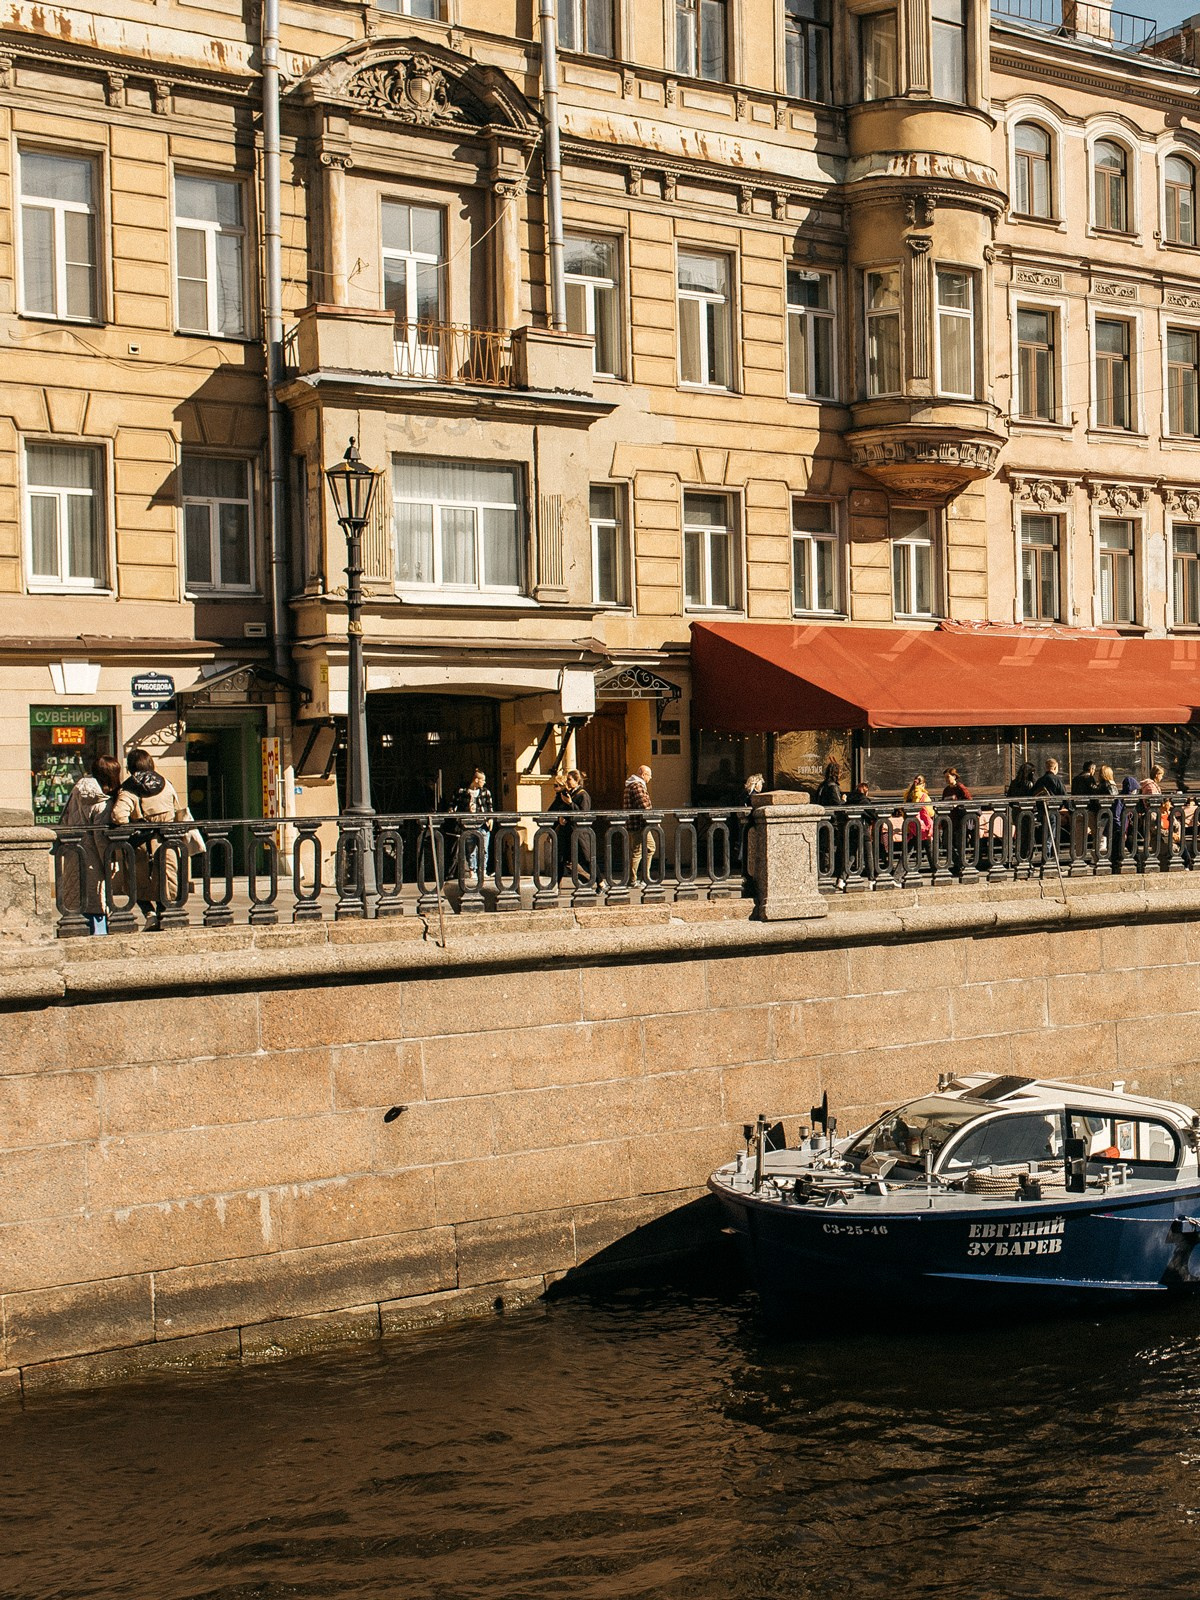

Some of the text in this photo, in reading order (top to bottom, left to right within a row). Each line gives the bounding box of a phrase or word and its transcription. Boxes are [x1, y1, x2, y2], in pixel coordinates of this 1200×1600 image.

[134, 683, 173, 691] ГРИБОЕДОВА
[150, 701, 159, 710] 10
[35, 711, 103, 723] СУВЕНИРЫ
[55, 728, 84, 738] 1+1=3
[35, 815, 61, 824] BENE
[968, 1215, 1066, 1238] ЕВГЕНИЙ
[967, 1238, 1063, 1257] ЗУБАРЕВ
